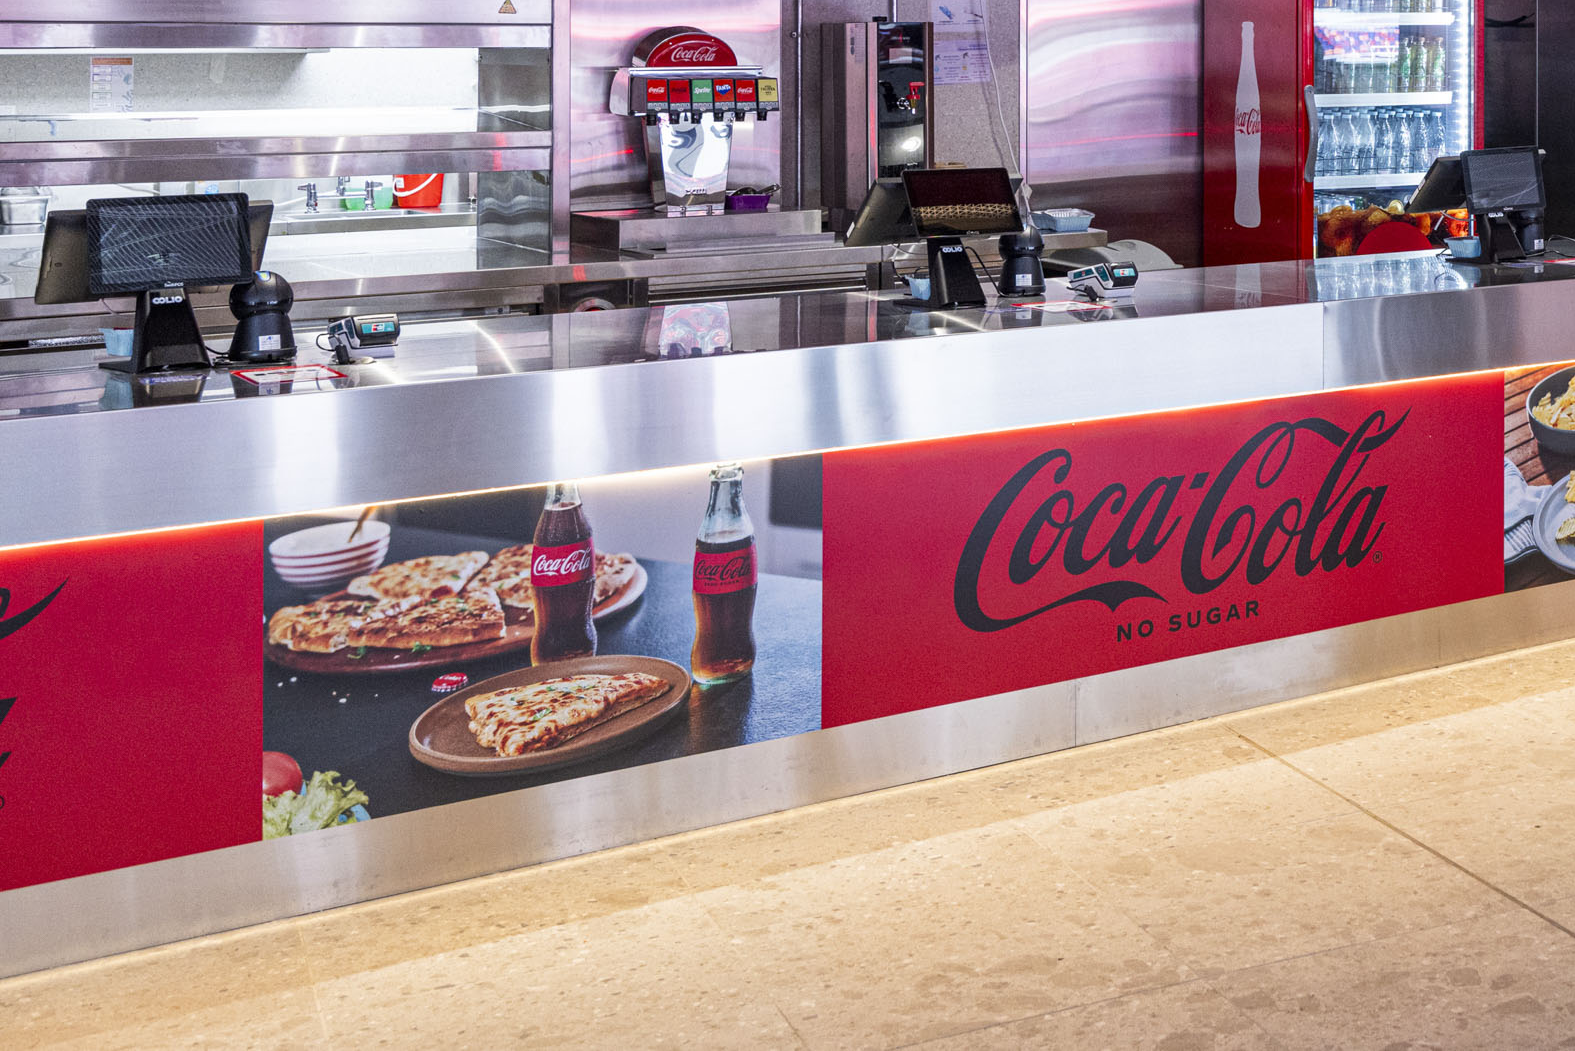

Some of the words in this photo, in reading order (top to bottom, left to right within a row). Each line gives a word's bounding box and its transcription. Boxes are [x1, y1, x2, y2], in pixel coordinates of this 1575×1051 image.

[671, 46, 719, 62] Coca-Cola
[953, 406, 1412, 633] Coca-Cola
[533, 547, 591, 576] Coca-Cola
[695, 556, 752, 581] Coca-Cola
[1116, 619, 1155, 642] NO
[1168, 600, 1260, 632] SUGAR
